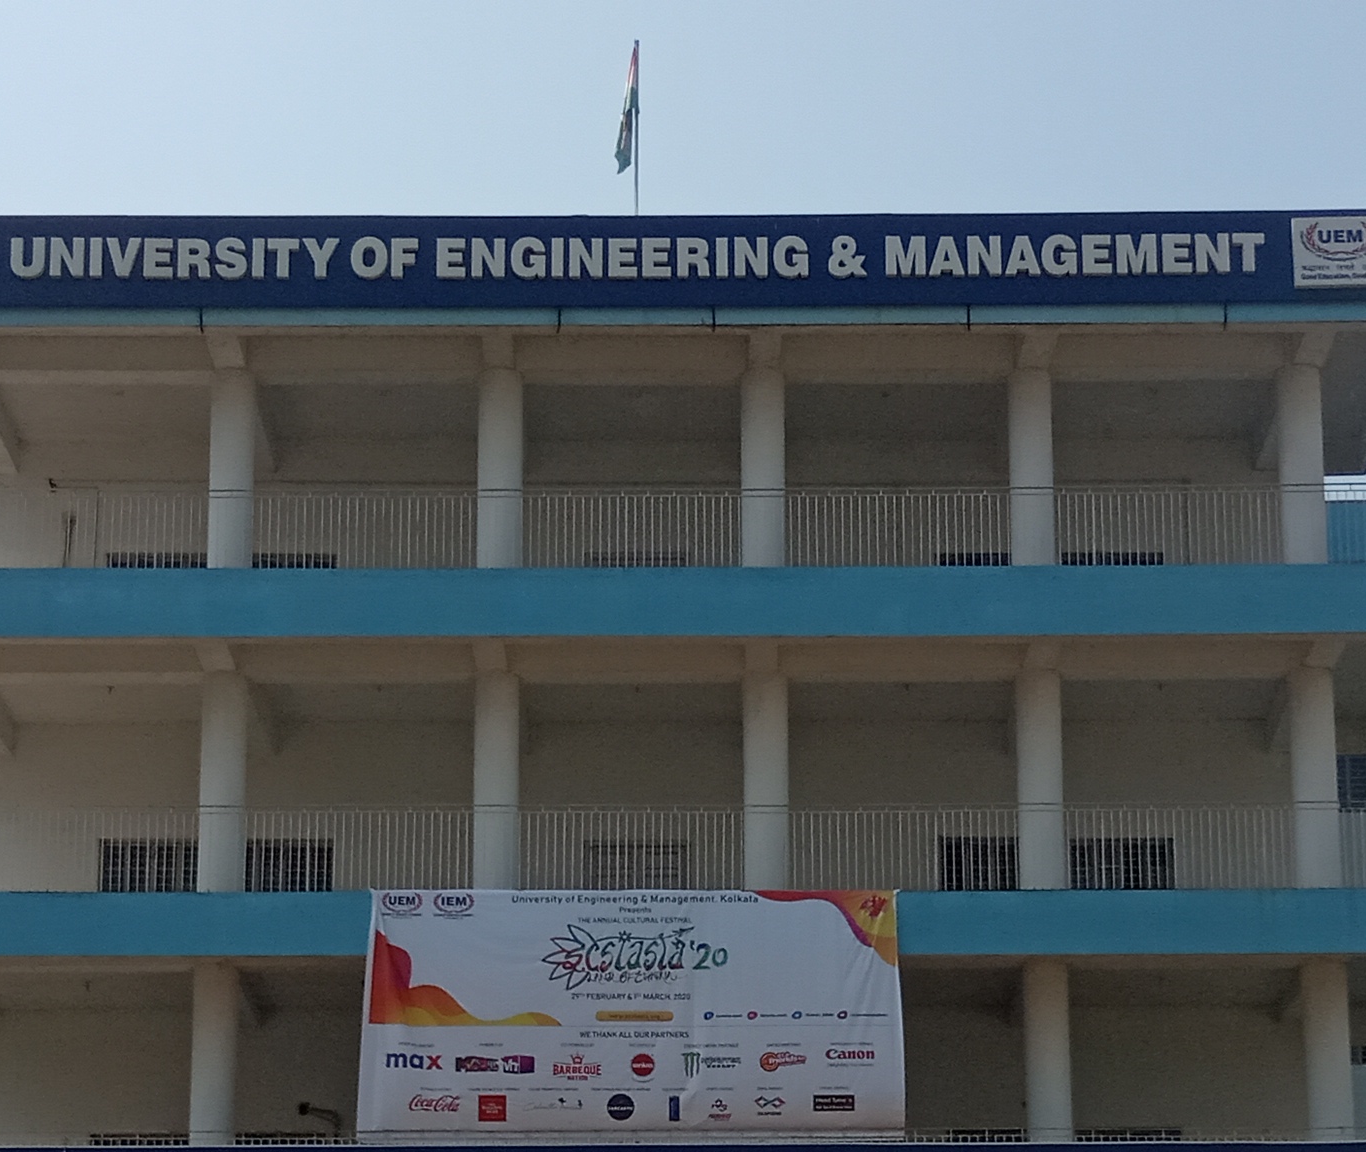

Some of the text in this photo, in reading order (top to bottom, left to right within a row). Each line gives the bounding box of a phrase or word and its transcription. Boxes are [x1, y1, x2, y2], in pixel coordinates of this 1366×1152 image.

[1318, 230, 1363, 243] UEM
[9, 231, 1267, 281] UNIVERSITY OF ENGINEERING & MANAGEMENT
[388, 895, 416, 906] UEM
[440, 896, 467, 907] IEM
[512, 894, 562, 905] University
[565, 894, 574, 904] of
[577, 895, 637, 906] Engineering
[640, 894, 648, 904] &
[720, 894, 759, 904] Kolkata
[619, 906, 652, 914] Presents
[825, 1048, 875, 1060] Canon
[385, 1052, 443, 1070] max
[553, 1063, 602, 1076] BARBEQUE
